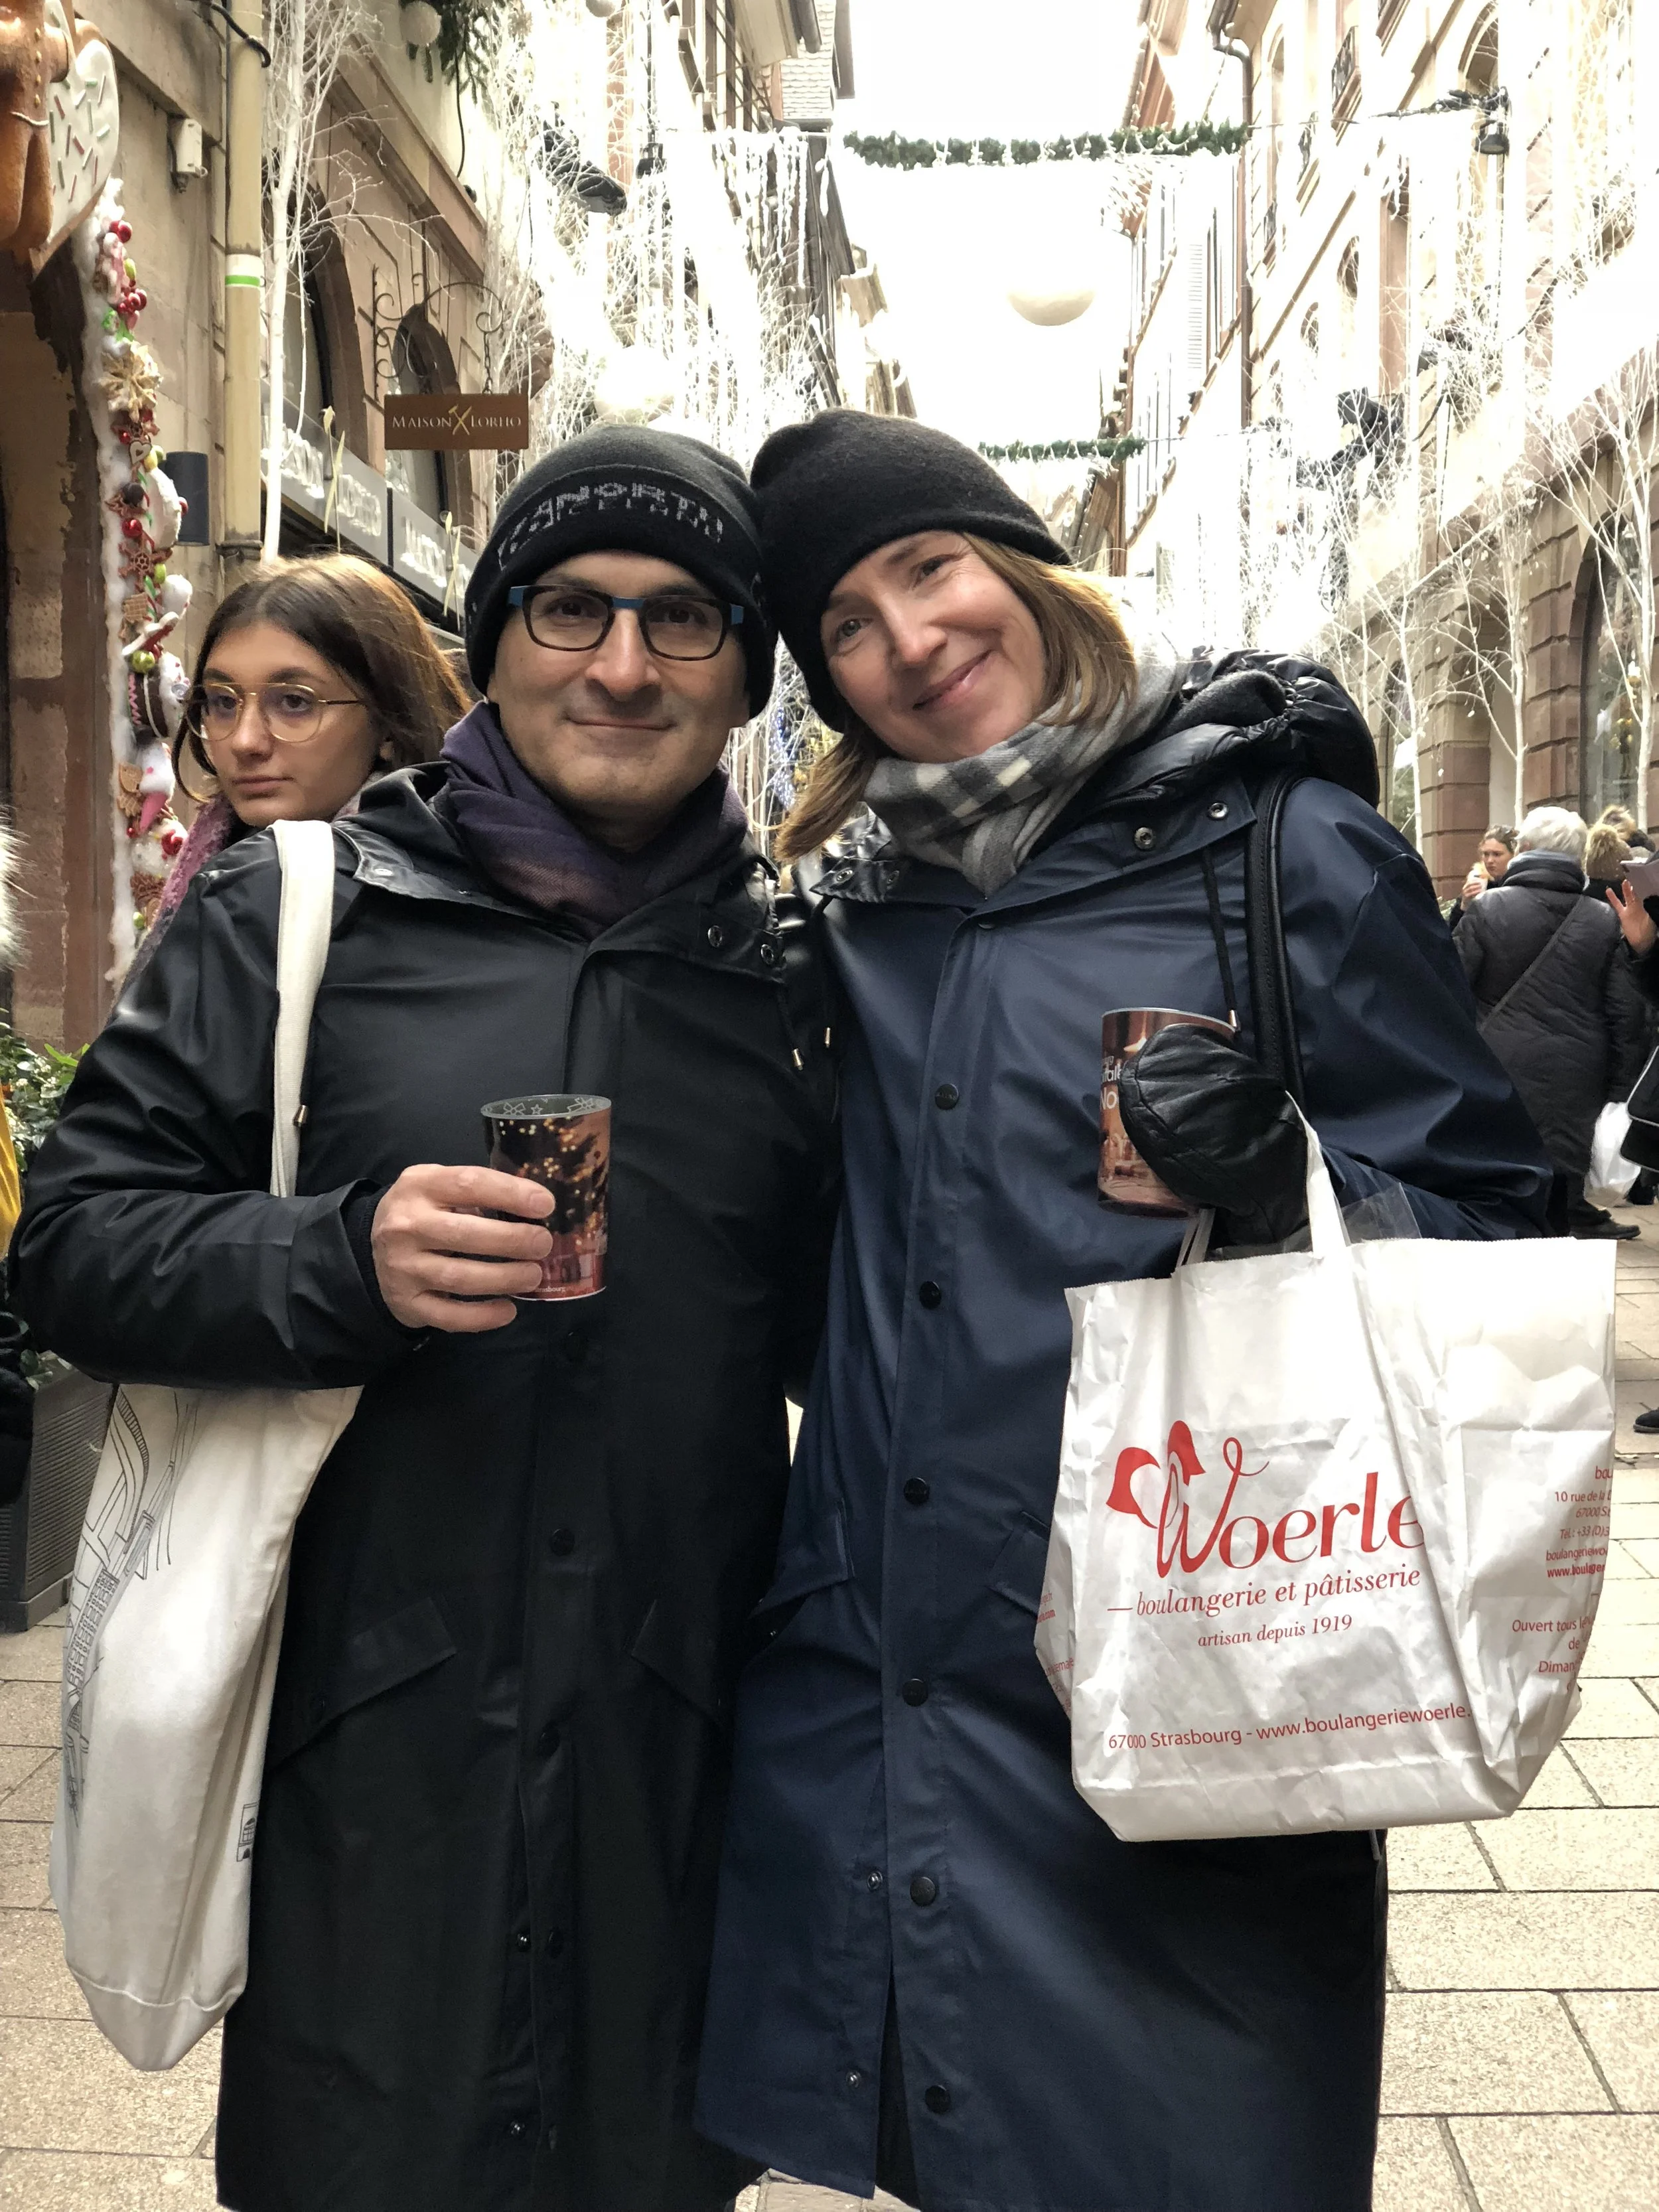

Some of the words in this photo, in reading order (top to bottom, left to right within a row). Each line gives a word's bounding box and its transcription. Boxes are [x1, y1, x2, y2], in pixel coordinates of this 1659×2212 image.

[392, 415, 451, 428] MAISON
[1595, 1465, 1613, 1480] bou
[1106, 1421, 1424, 1578] Woerle
[1555, 1491, 1568, 1502] 10
[1571, 1493, 1586, 1502] rue
[1587, 1490, 1598, 1501] de
[1136, 1582, 1266, 1617] boulangerie
[1275, 1582, 1296, 1603] et
[1304, 1563, 1420, 1606] pâtisserie
[1197, 1629, 1252, 1647] artisan
[1258, 1620, 1306, 1645] depuis
[1312, 1614, 1352, 1635] 1919
[1512, 1619, 1553, 1632] Ouvert
[1556, 1619, 1577, 1632] tous
[1568, 1636, 1581, 1651] de
[1538, 1660, 1577, 1673] Diman
[1108, 1734, 1147, 1749] 67000
[1150, 1728, 1242, 1747] Strasbourg
[1256, 1702, 1471, 1740] www.boulangeriewoerle.
